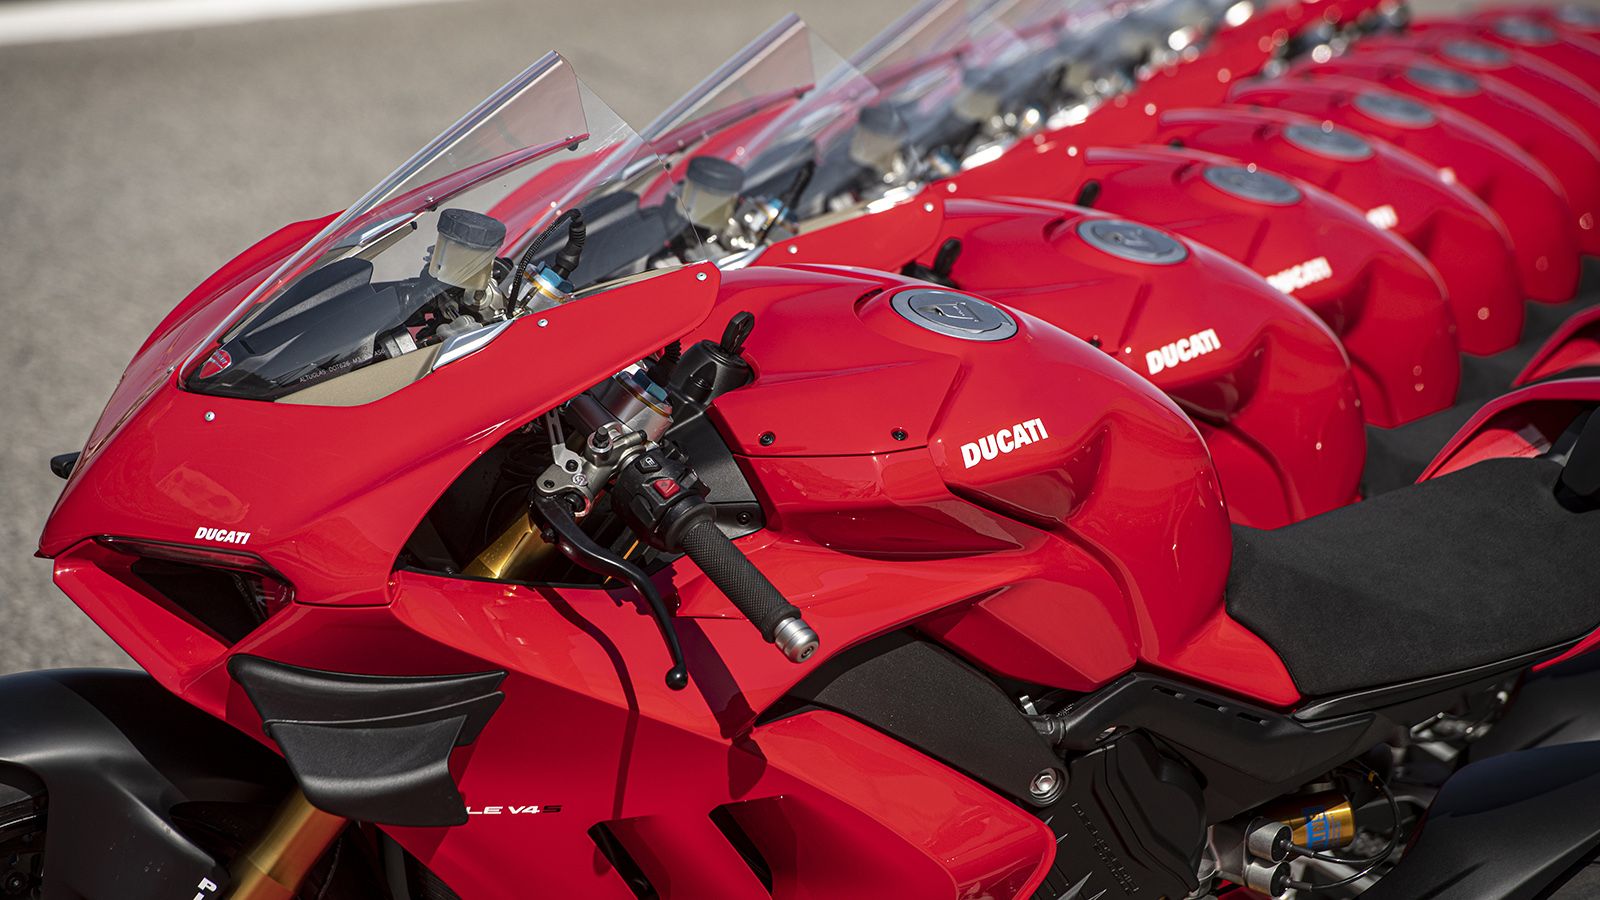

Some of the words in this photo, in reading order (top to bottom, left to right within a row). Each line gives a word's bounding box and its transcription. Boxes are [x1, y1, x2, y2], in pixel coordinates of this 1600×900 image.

[1146, 328, 1221, 375] DUCATI
[960, 417, 1049, 469] DUCATI
[194, 526, 251, 545] DUCATI
